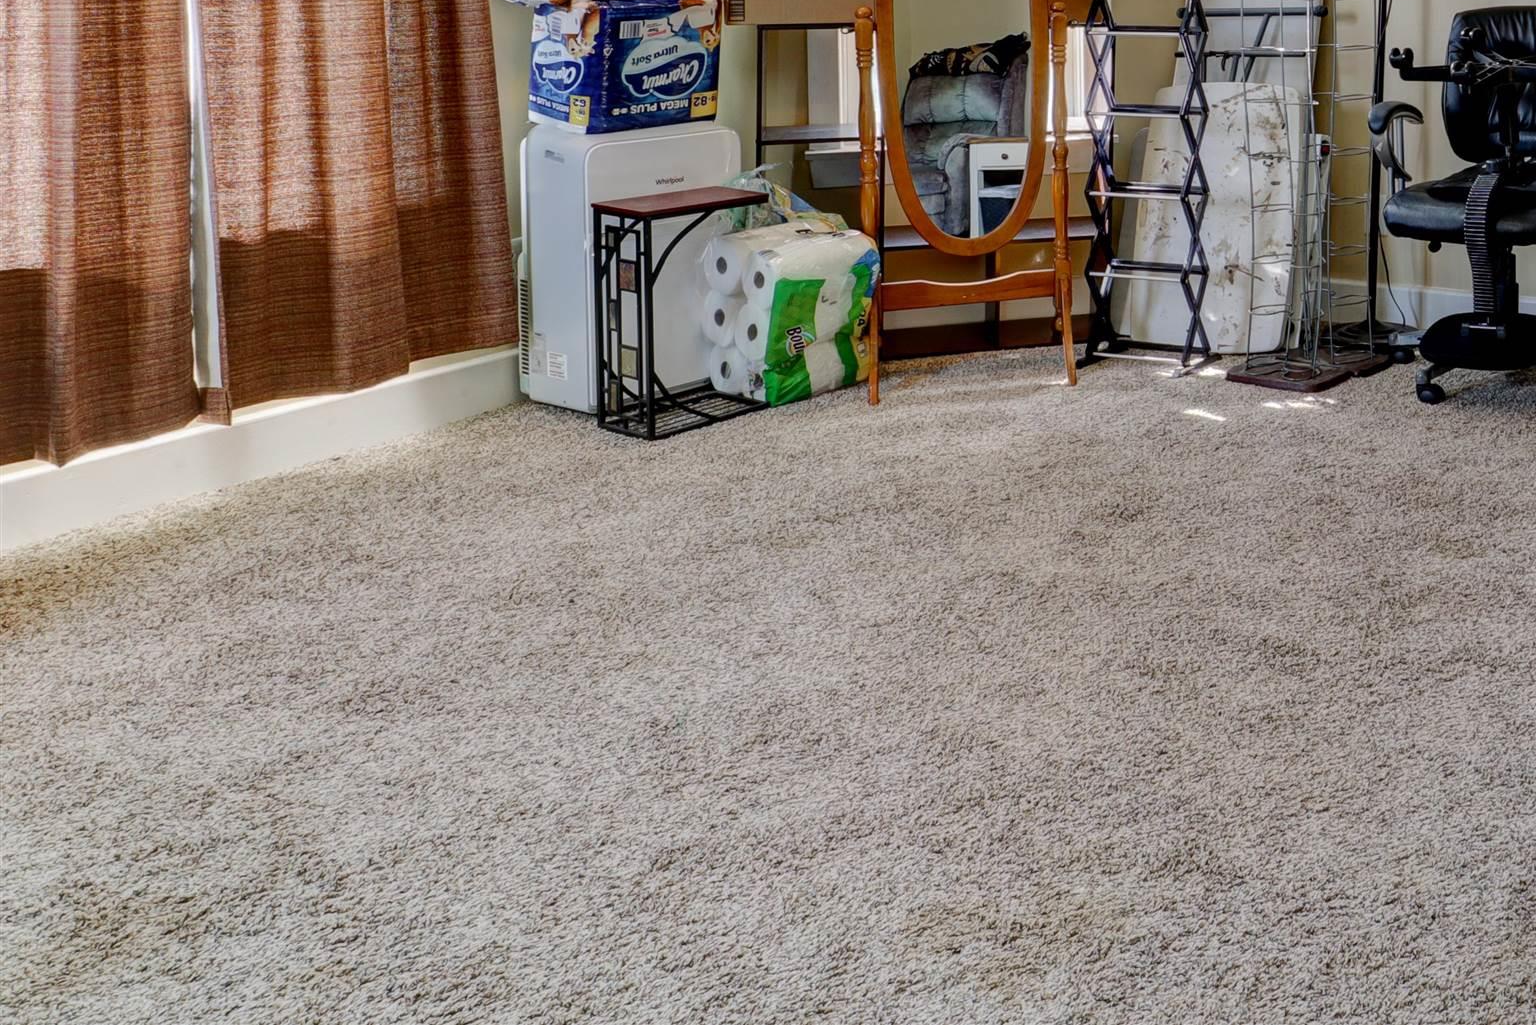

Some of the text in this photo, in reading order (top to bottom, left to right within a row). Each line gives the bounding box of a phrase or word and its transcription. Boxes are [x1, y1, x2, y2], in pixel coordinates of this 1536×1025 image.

[631, 45, 679, 66] Ultra Soft
[542, 66, 576, 84] Charmin
[642, 59, 699, 90] Charmin
[660, 99, 689, 111] MEGA
[693, 96, 708, 107] 82
[630, 103, 658, 114] PLUS
[655, 175, 685, 185] Whirlpool
